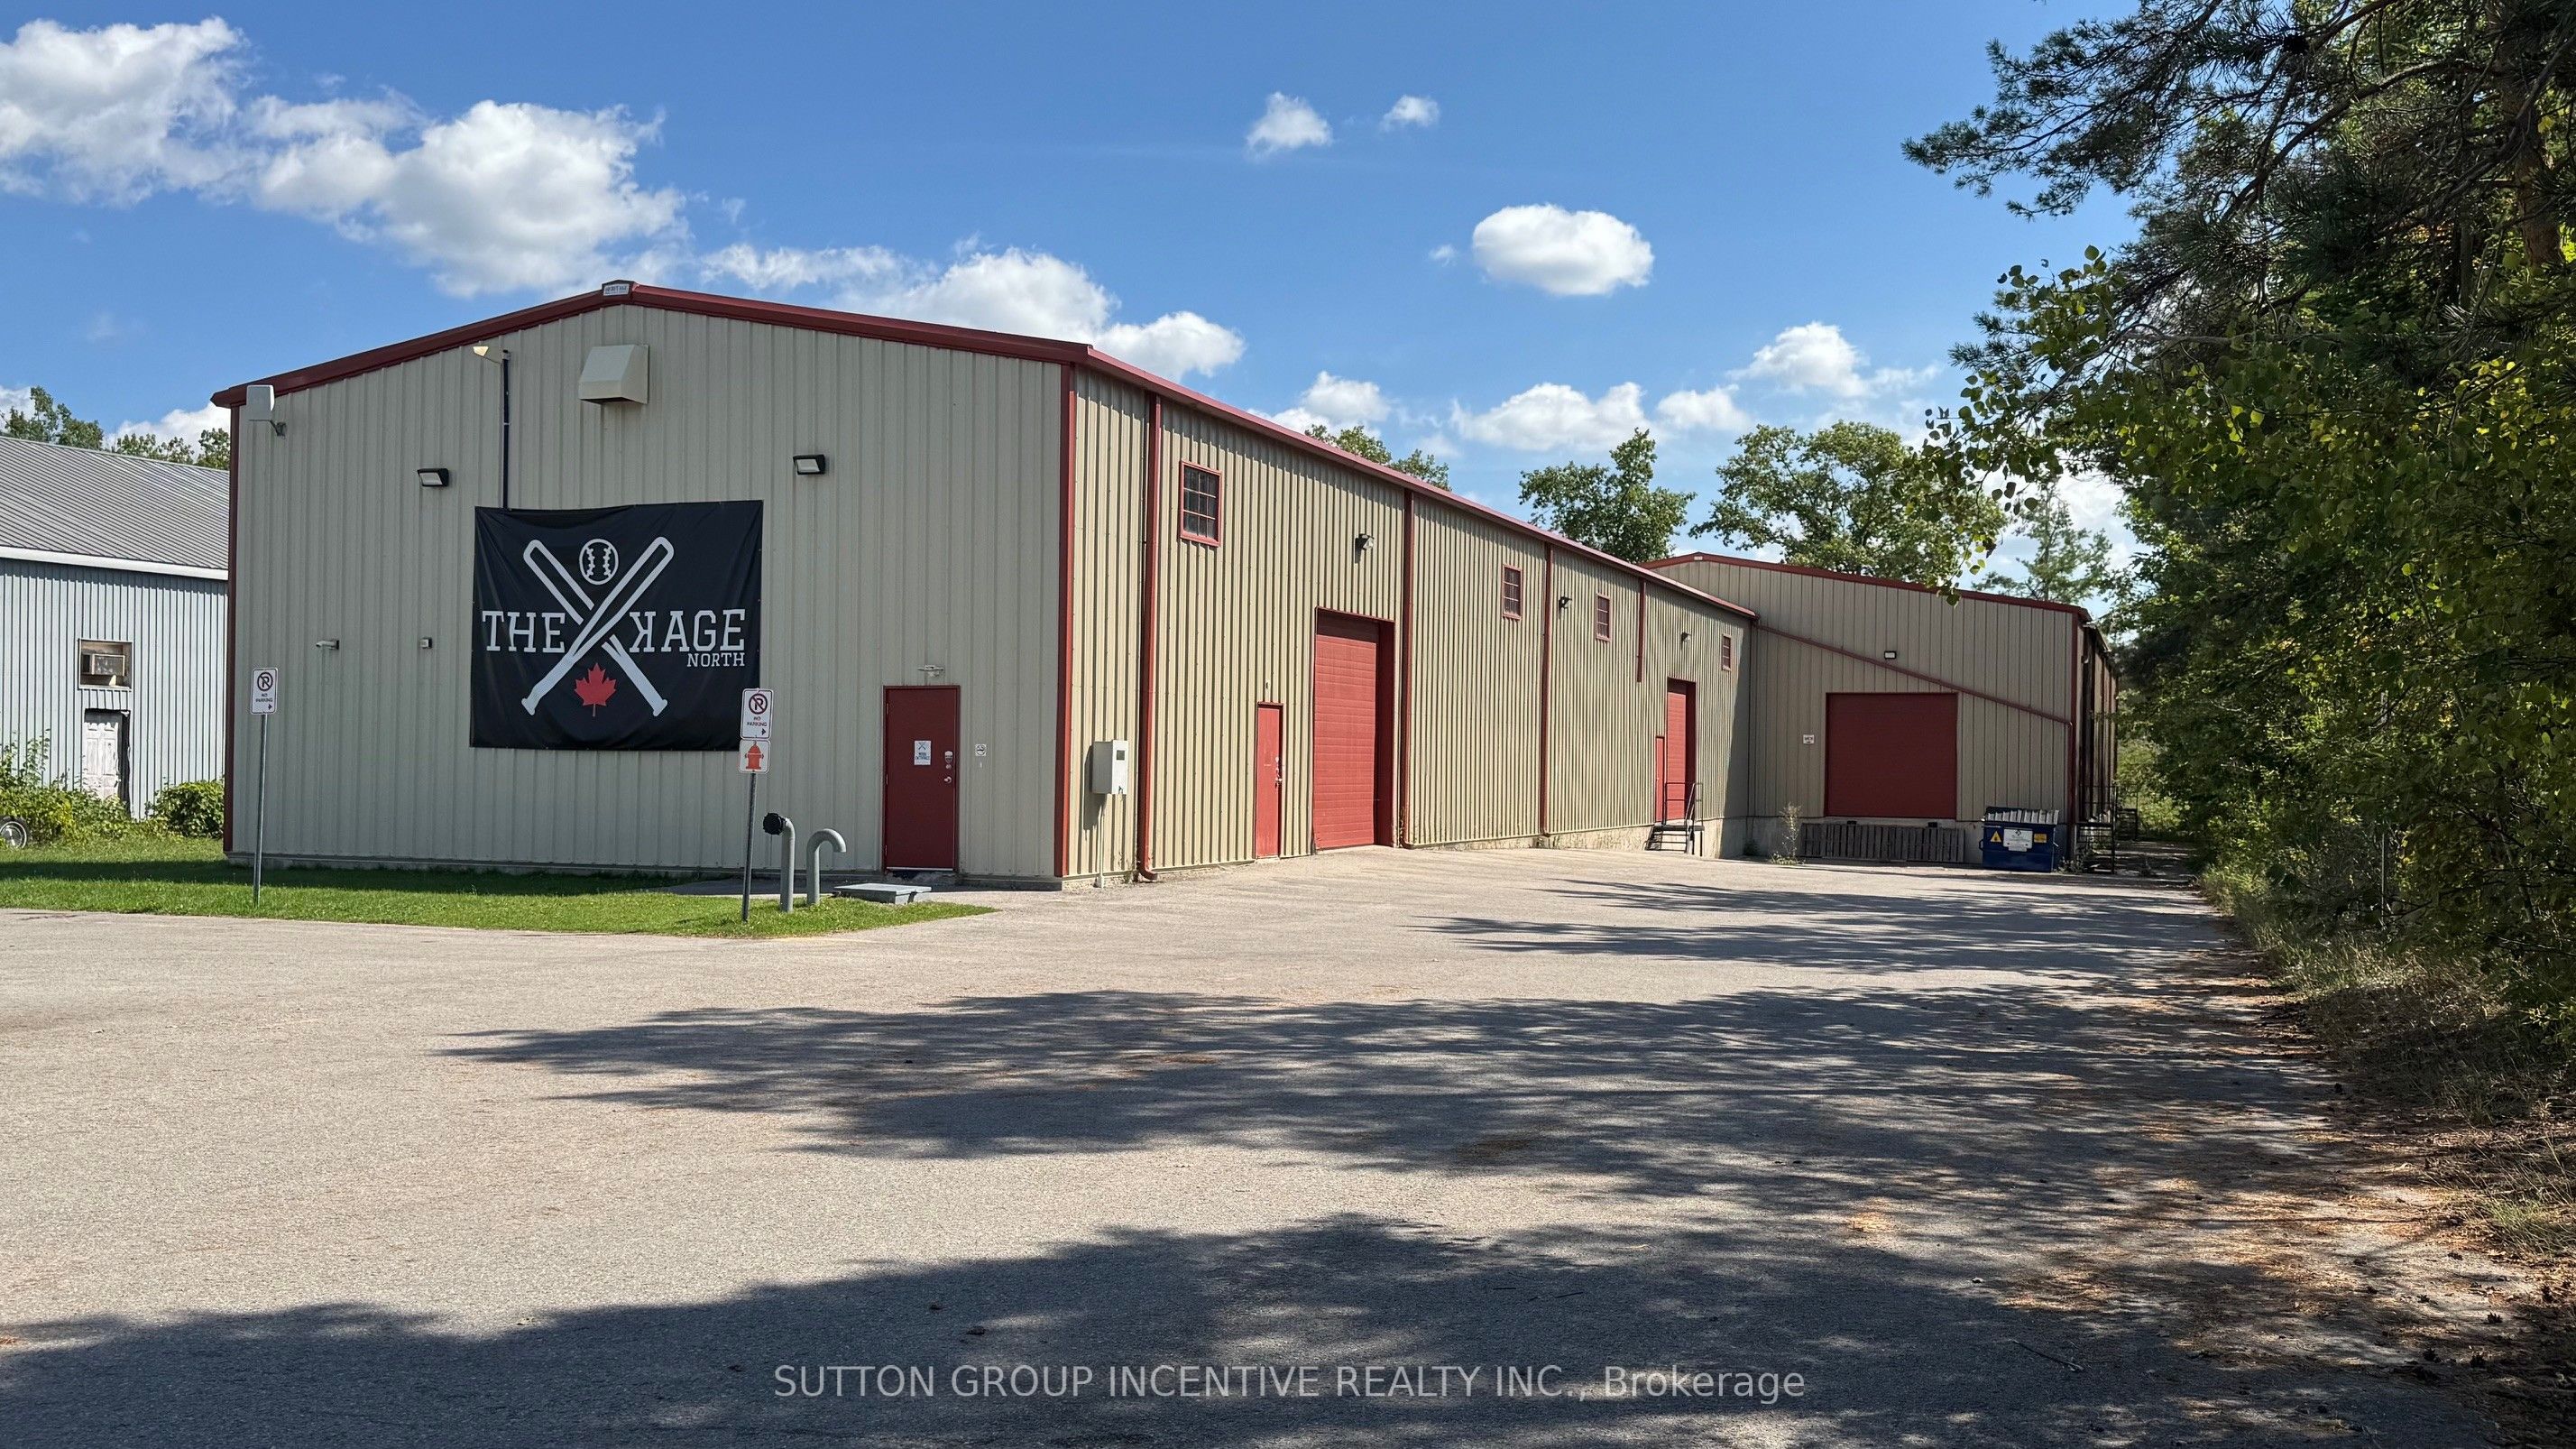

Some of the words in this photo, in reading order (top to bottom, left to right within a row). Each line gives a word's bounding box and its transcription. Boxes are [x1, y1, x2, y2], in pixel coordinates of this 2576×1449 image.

[482, 610, 566, 653] THE
[629, 608, 746, 652] KAGE
[686, 652, 745, 667] NORTH
